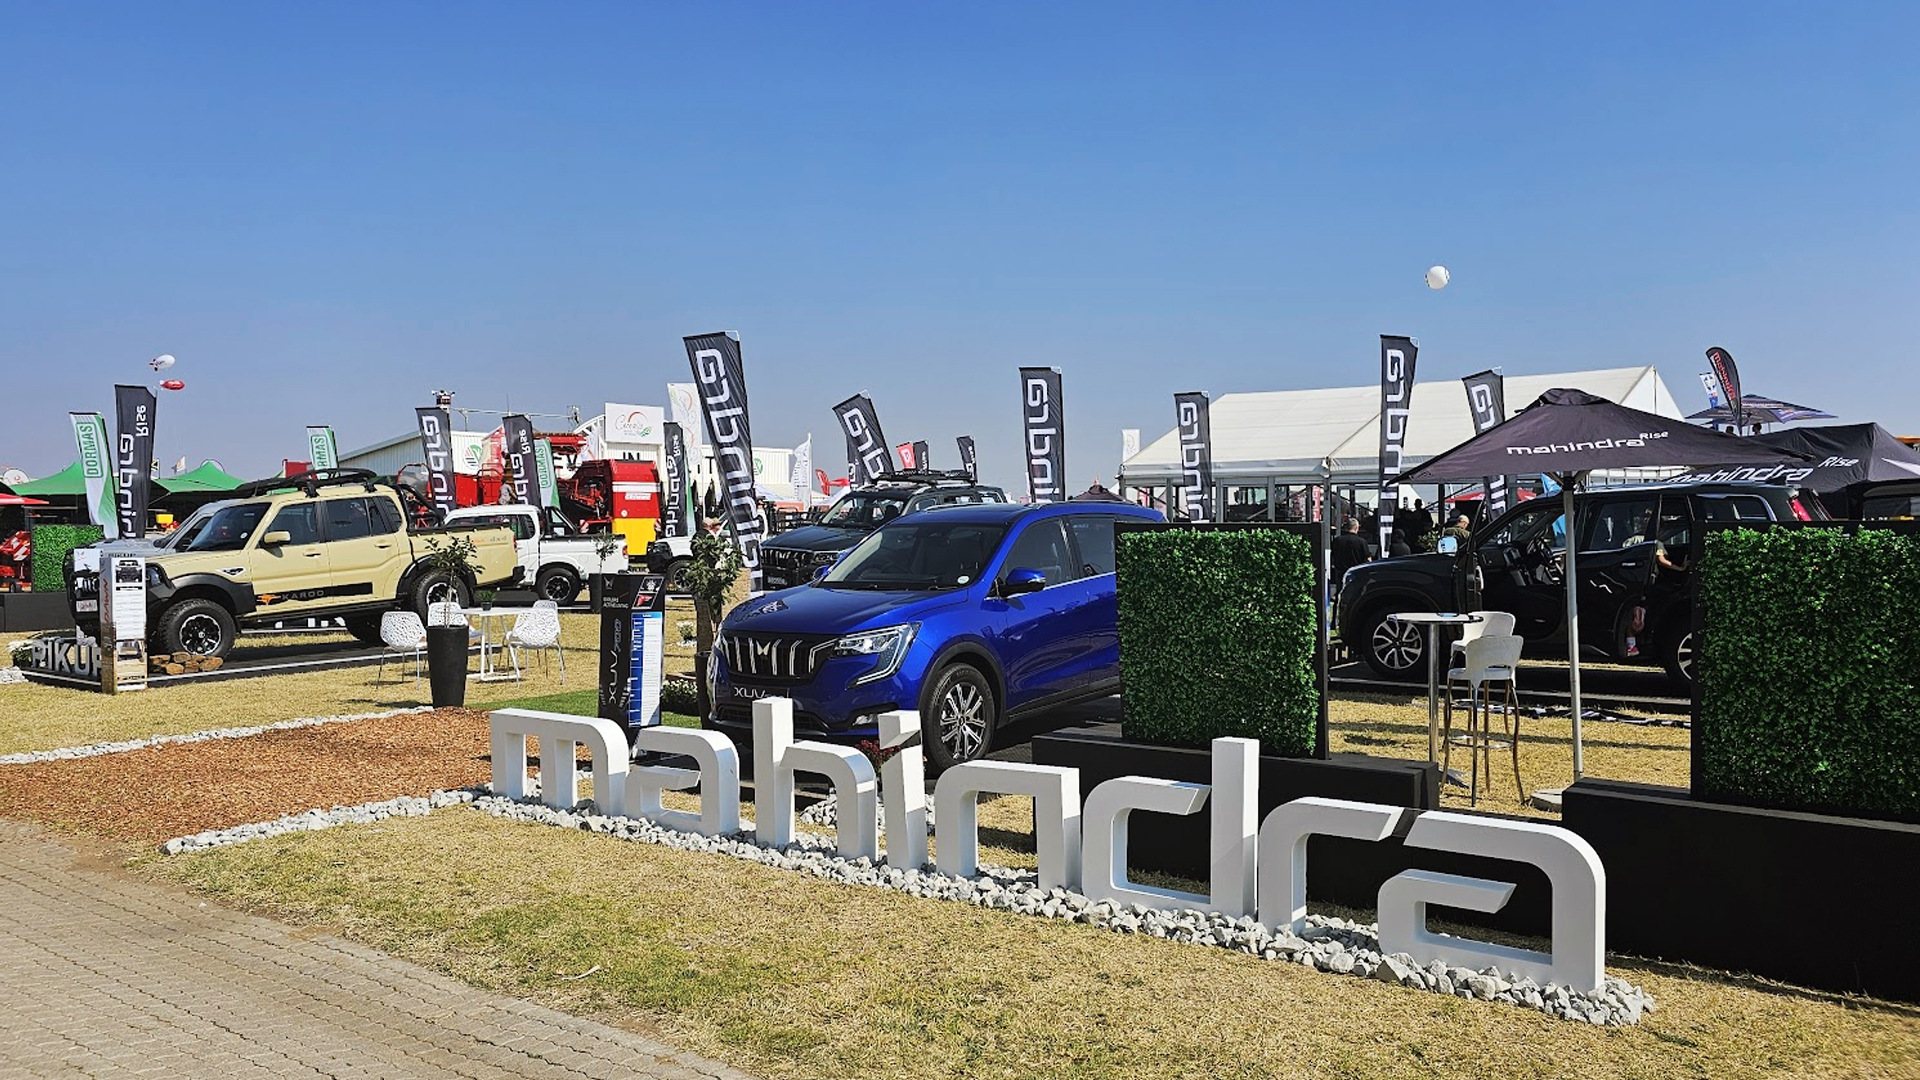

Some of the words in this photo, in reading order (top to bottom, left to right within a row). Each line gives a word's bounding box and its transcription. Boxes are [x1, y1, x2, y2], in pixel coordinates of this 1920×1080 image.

[79, 424, 99, 476] DORMAS
[314, 436, 327, 468] RMAS
[1506, 438, 1646, 455] mahindra
[1639, 431, 1669, 441] Rise
[1818, 456, 1860, 468] Rise
[490, 696, 1606, 991] mahindra
